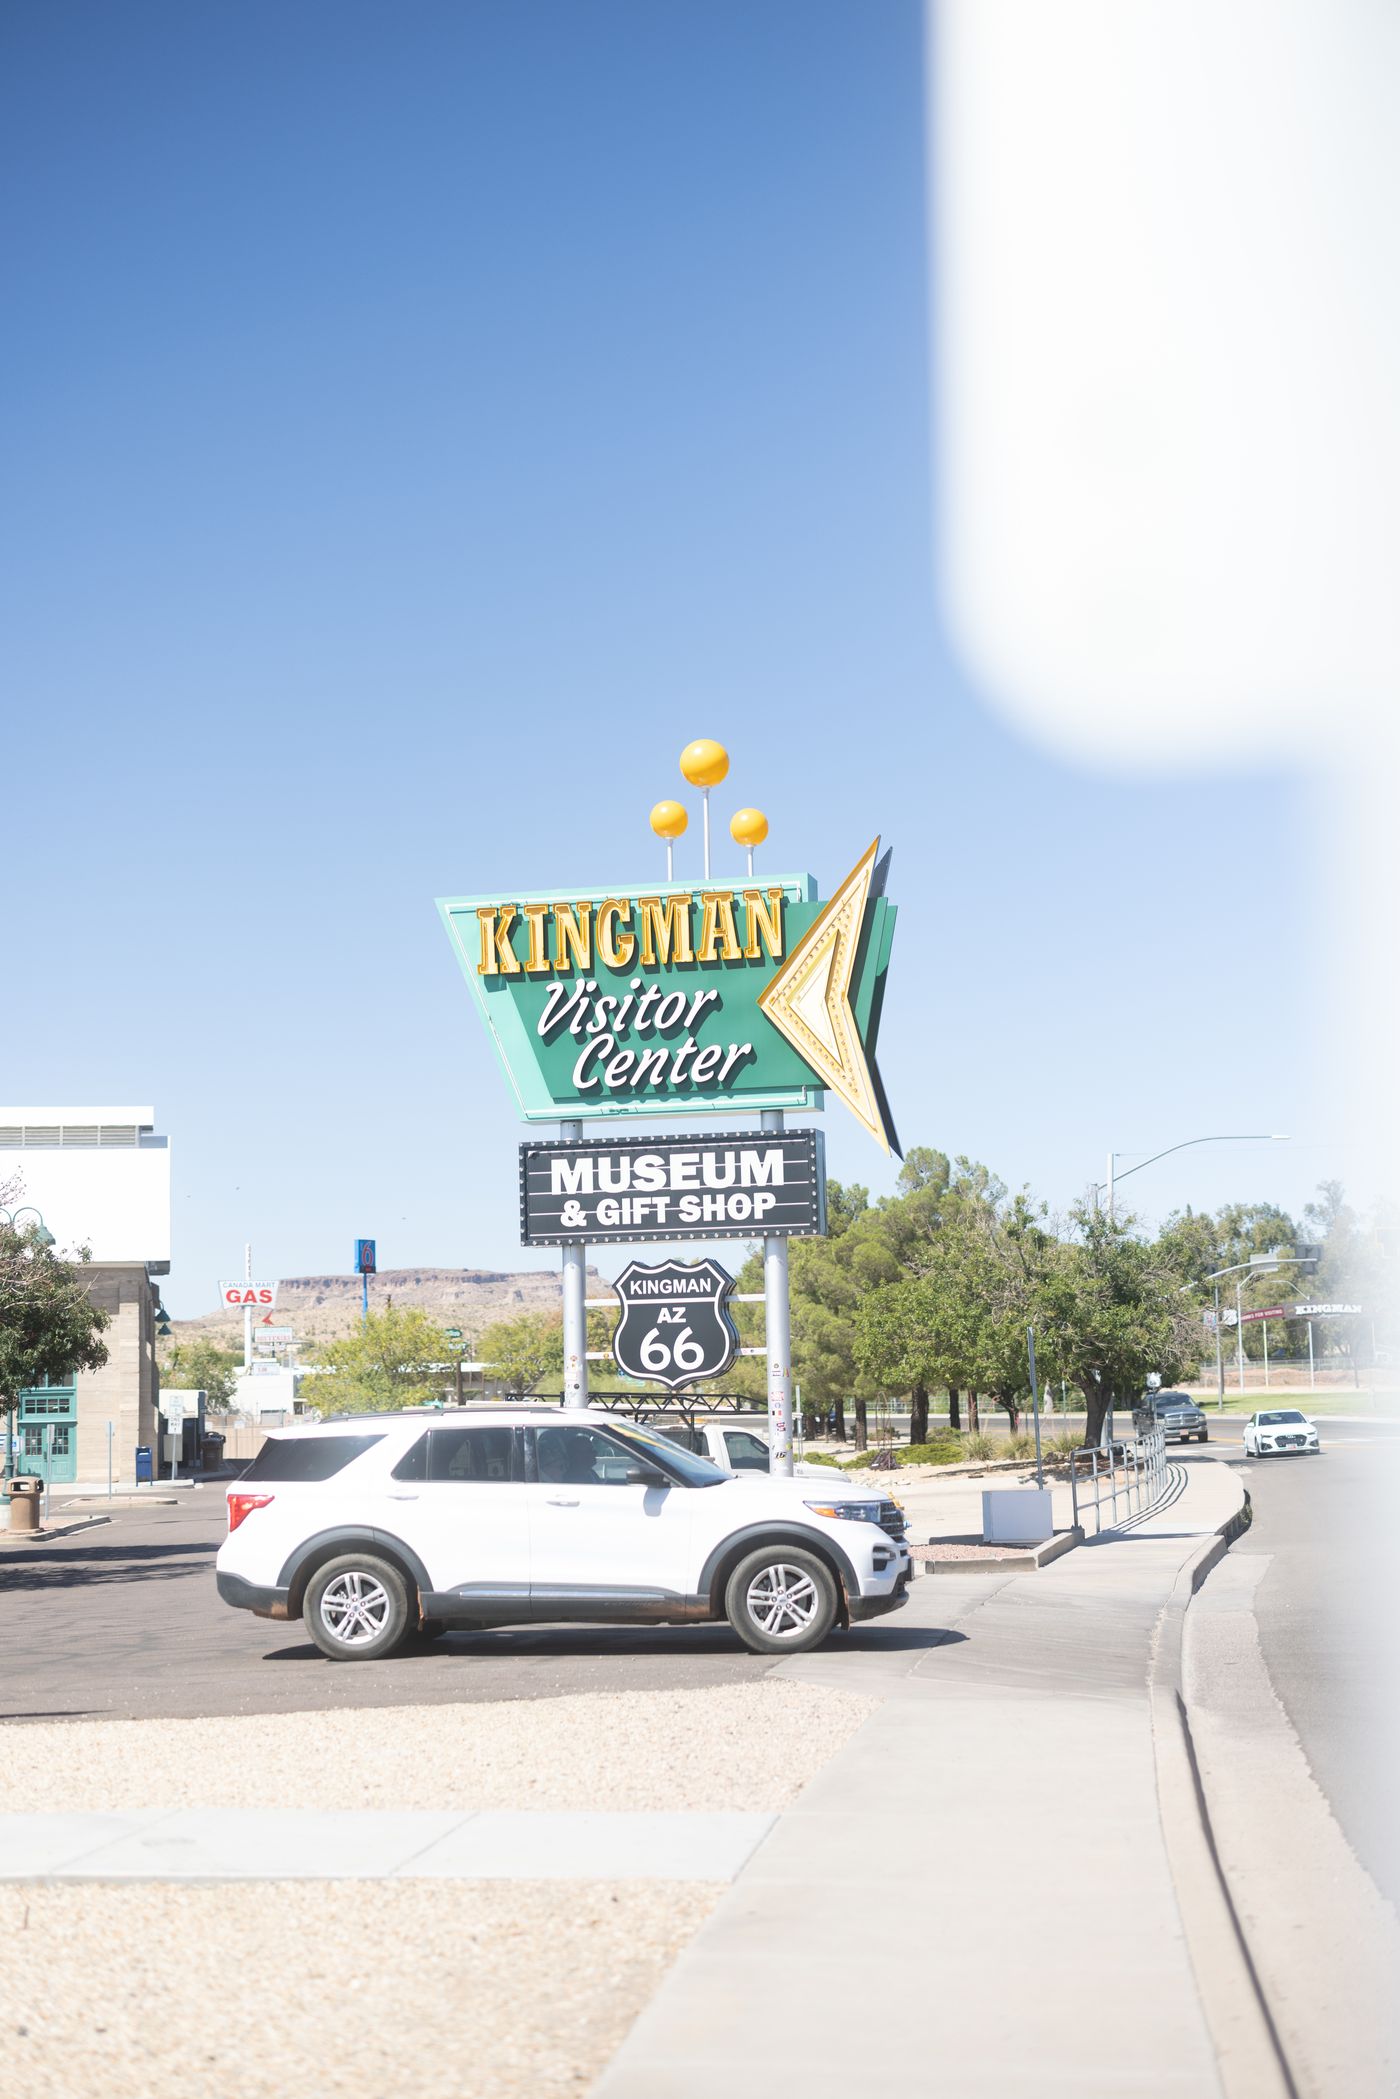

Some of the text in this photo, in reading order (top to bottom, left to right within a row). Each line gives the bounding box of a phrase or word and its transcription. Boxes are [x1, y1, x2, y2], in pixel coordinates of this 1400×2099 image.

[476, 888, 784, 976] KINGMAN
[537, 977, 718, 1036] Visitor
[571, 1036, 752, 1090] Center
[550, 1149, 784, 1195] MUSEUM
[560, 1192, 776, 1227] & GIFT SHOP
[226, 1290, 272, 1303] GAS
[630, 1277, 711, 1295] KINGMAN
[656, 1307, 686, 1324] AZ
[1295, 1304, 1361, 1314] KINGMAN
[640, 1326, 704, 1371] 66
